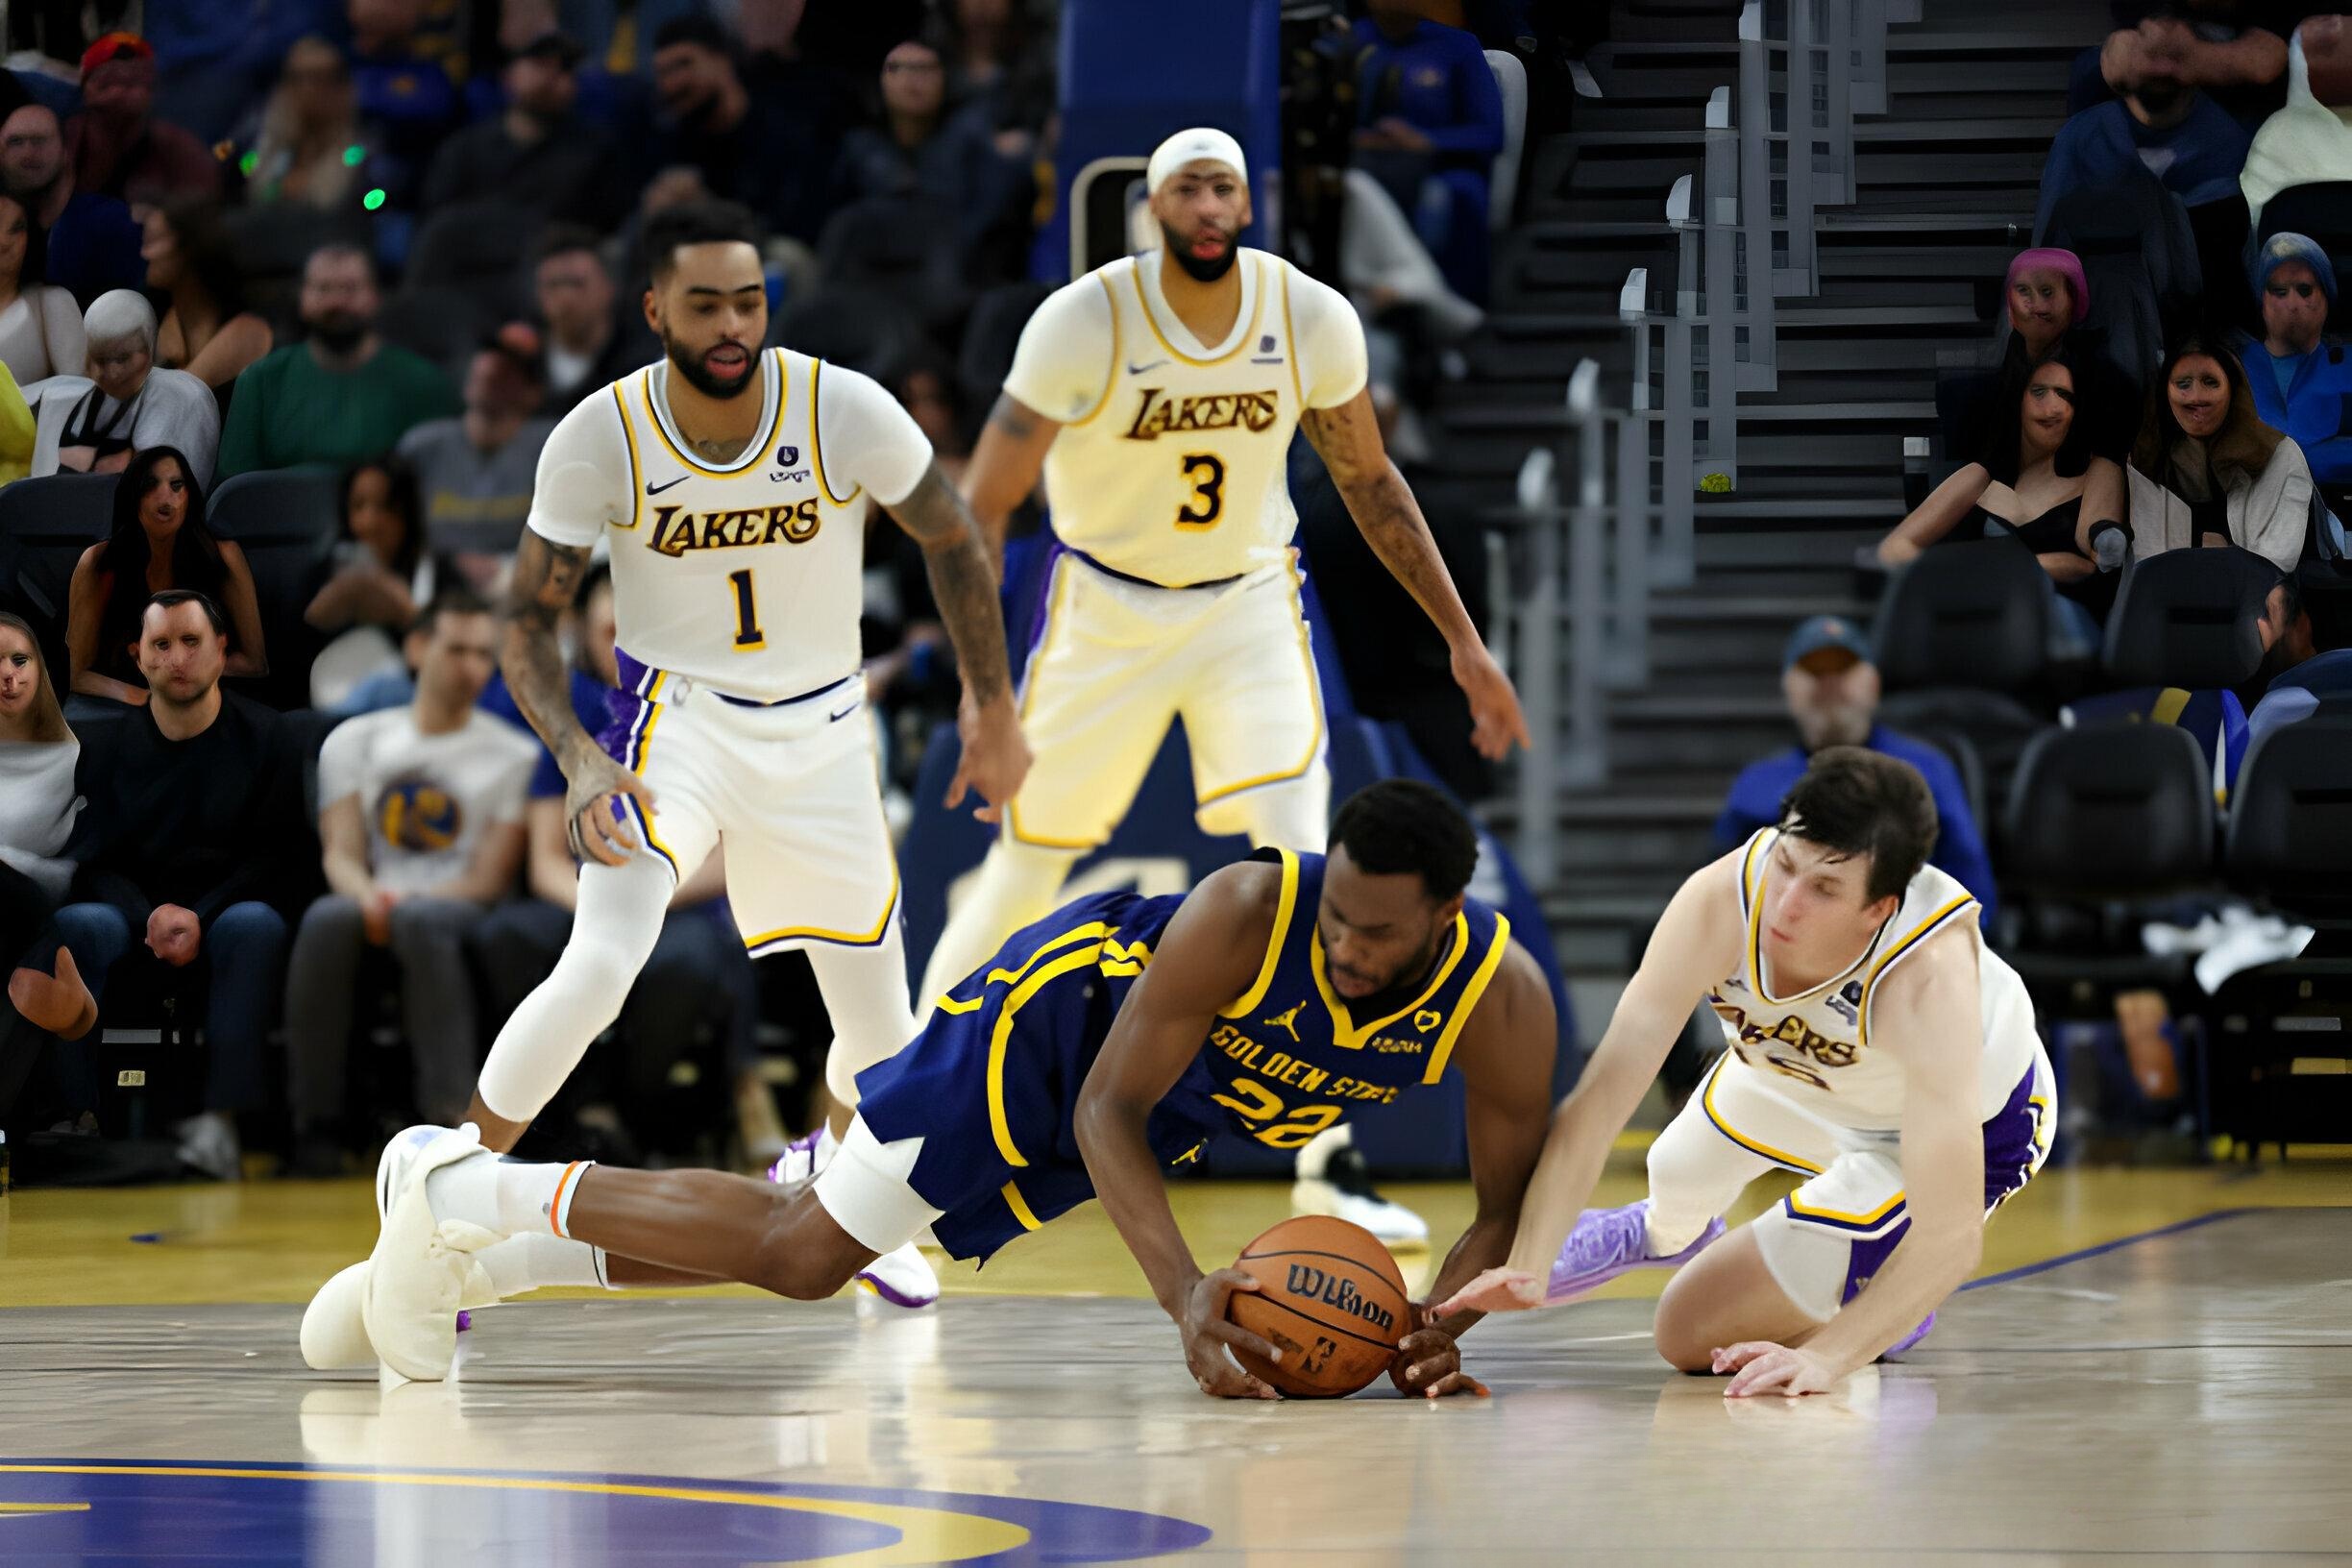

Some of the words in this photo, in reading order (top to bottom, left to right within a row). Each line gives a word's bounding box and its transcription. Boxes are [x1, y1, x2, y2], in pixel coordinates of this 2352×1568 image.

[1124, 388, 1279, 441] LAKERS
[647, 496, 821, 557] LAKERS
[1175, 451, 1227, 532] 3
[728, 568, 767, 652] 1
[1210, 1024, 1331, 1093] GOLDEN
[1211, 1077, 1344, 1150] 22
